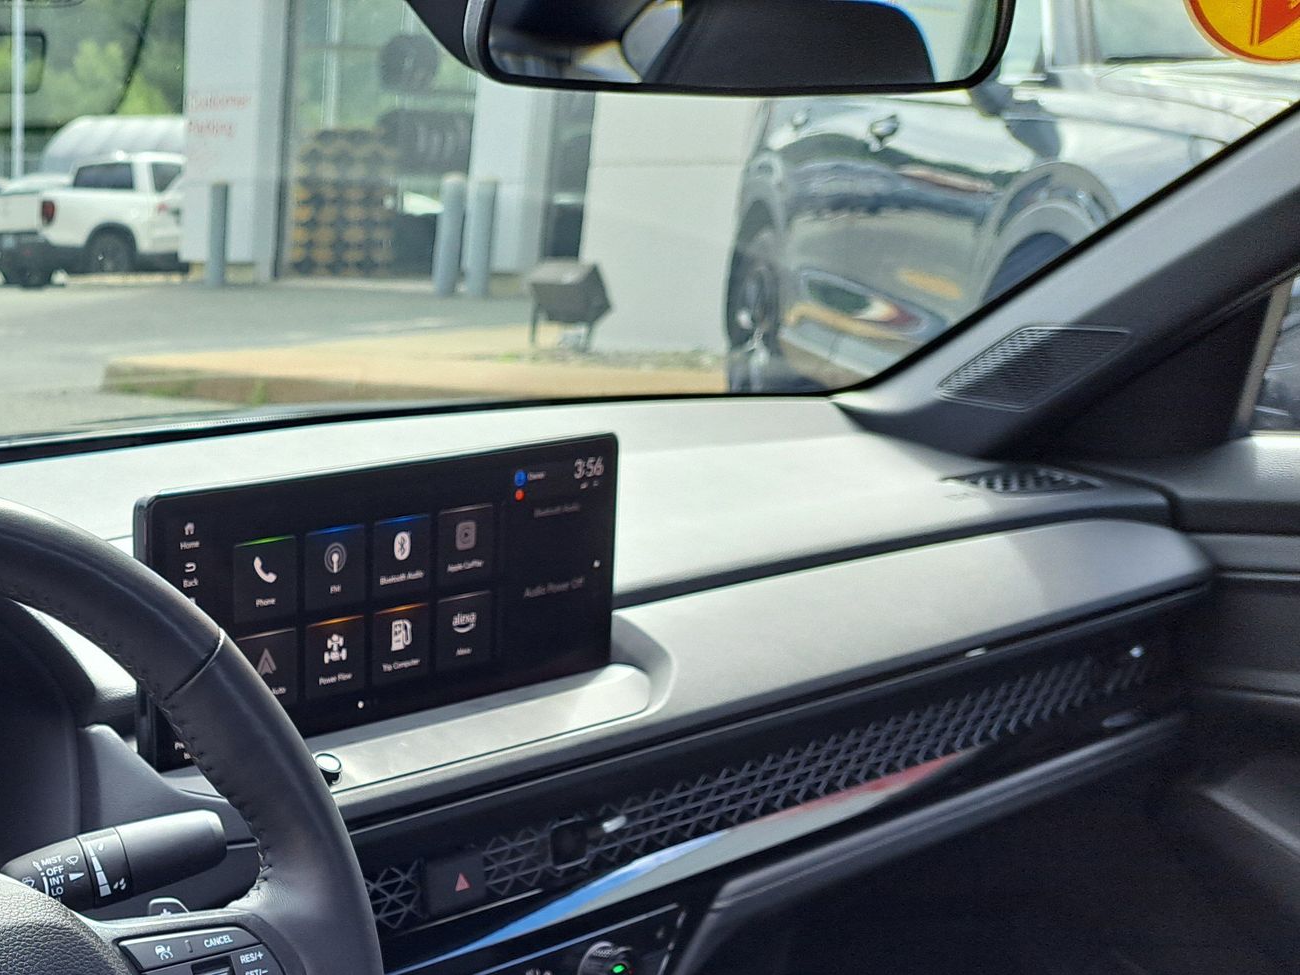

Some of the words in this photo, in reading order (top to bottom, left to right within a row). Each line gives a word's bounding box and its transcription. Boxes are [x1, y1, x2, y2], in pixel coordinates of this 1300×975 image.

[573, 456, 604, 479] 3:56
[180, 540, 200, 550] Home
[182, 577, 199, 588] Back
[255, 598, 276, 608] Phone
[41, 854, 62, 866] MIST
[46, 865, 64, 876] OFF
[49, 875, 65, 886] INT
[51, 886, 64, 897] LO
[203, 934, 234, 948] CANCEL
